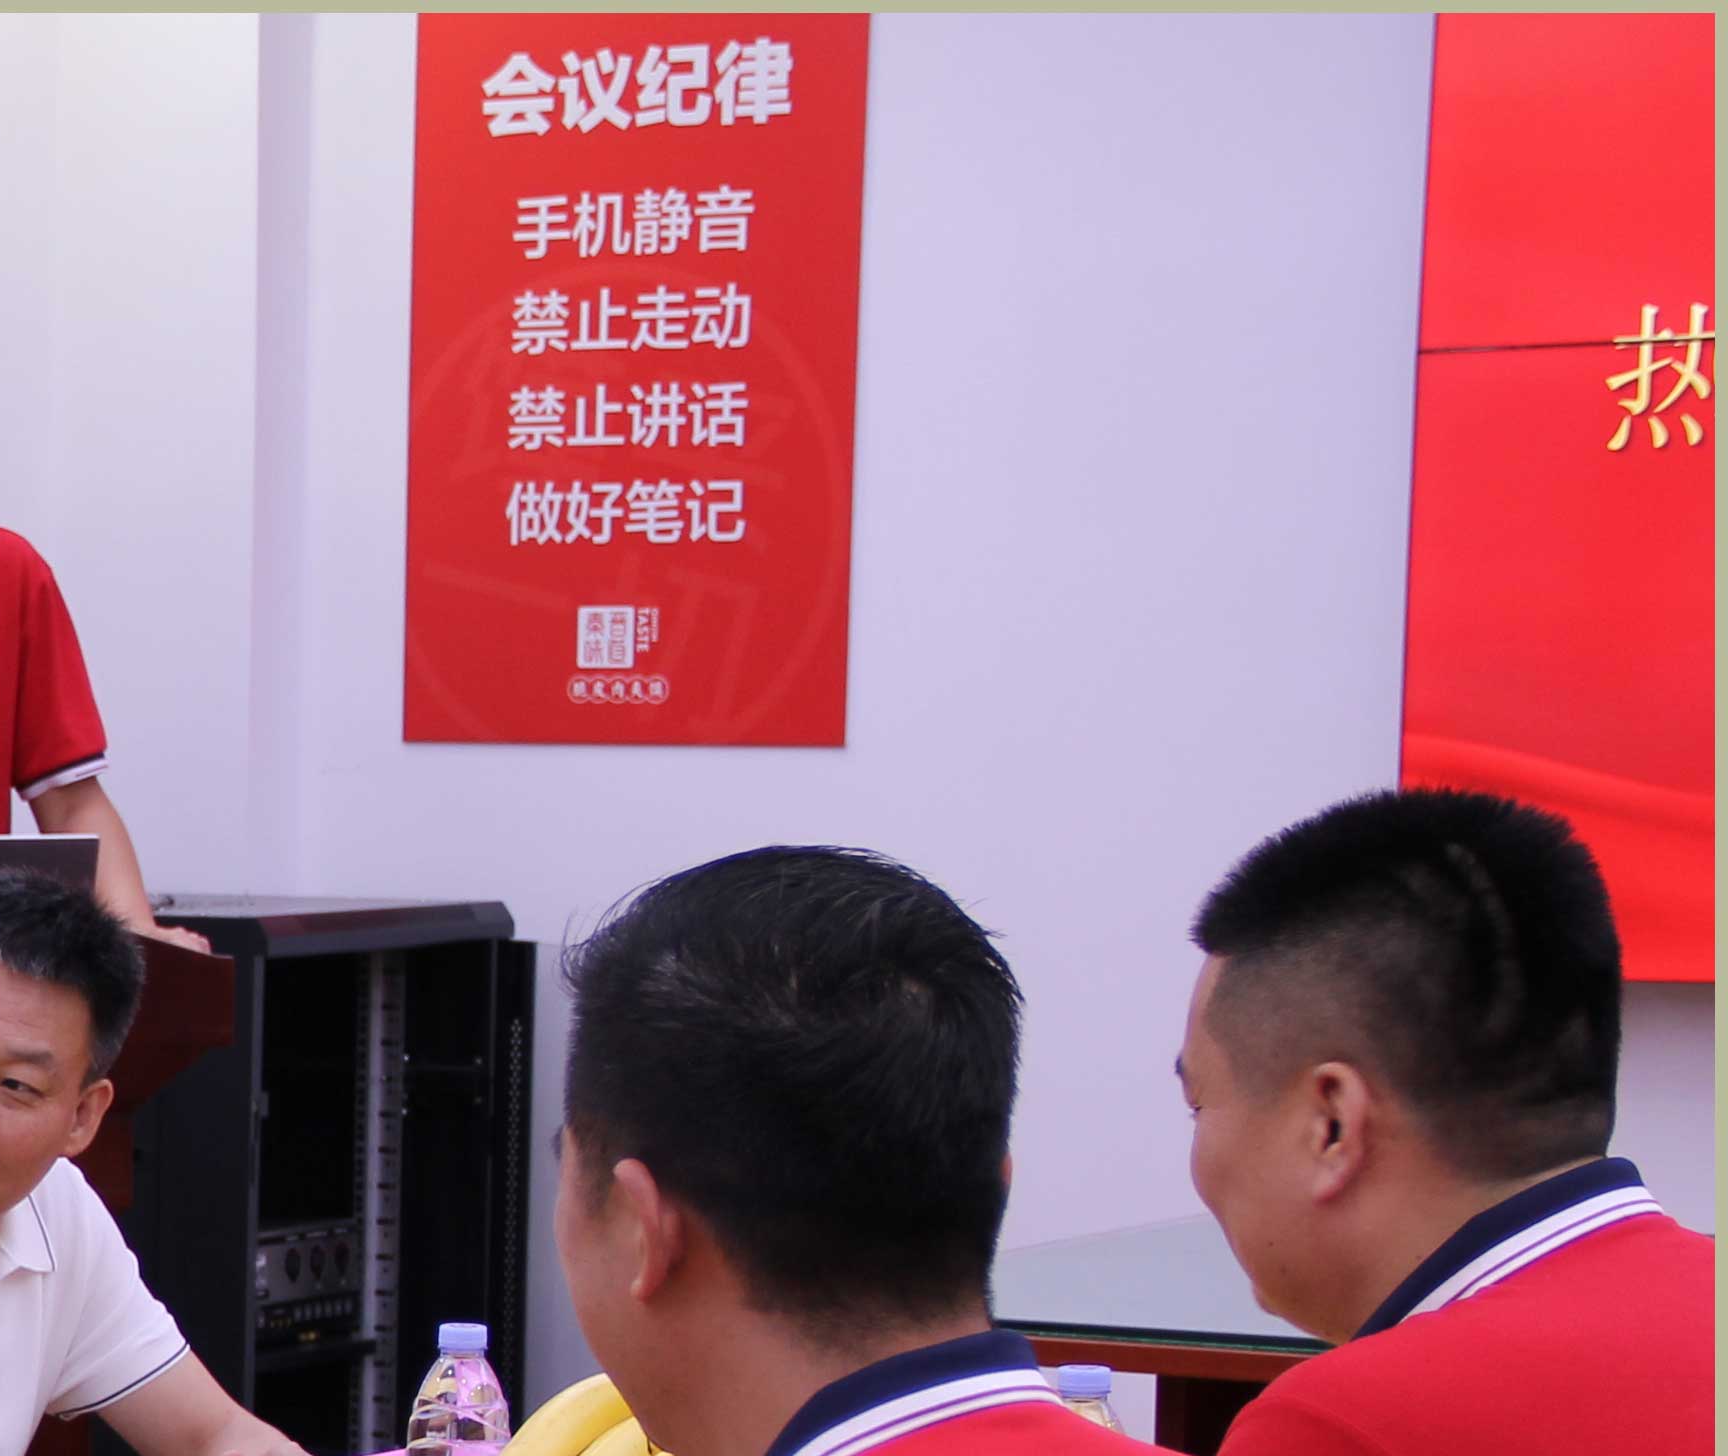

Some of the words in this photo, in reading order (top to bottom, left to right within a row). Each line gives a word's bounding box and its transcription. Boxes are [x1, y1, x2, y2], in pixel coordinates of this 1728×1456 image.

[481, 37, 793, 137] 会议纪律
[512, 185, 755, 260] 手机静音
[511, 282, 753, 356] 禁止走动
[1605, 302, 1715, 451] 热
[507, 381, 749, 451] 禁止讲话
[505, 478, 746, 546] 做好笔记
